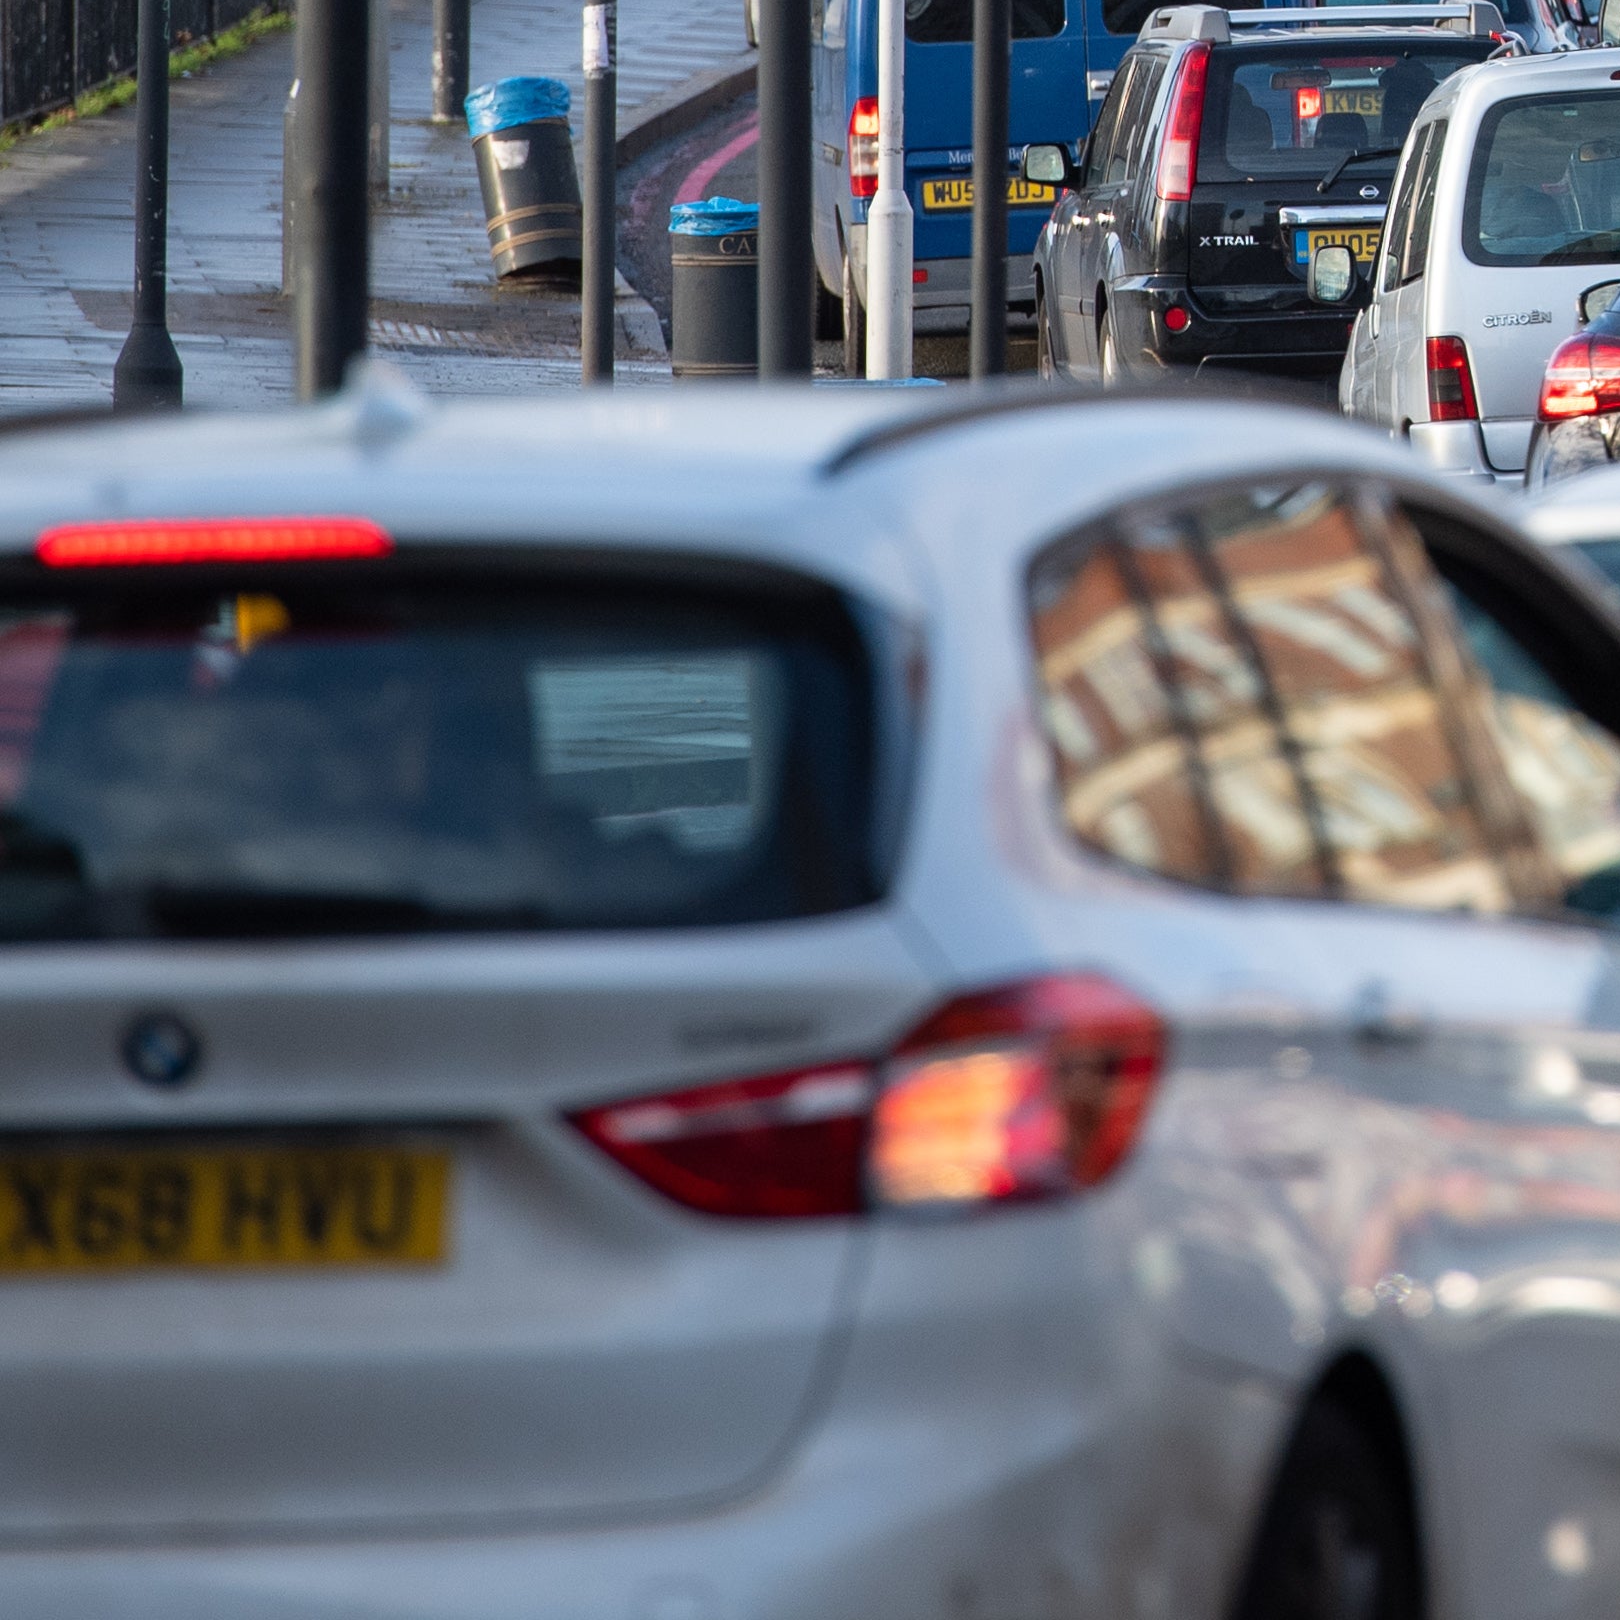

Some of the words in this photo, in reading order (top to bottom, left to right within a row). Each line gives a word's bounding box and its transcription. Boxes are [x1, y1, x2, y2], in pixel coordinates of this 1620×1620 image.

[1199, 236, 1212, 247] X
[1213, 235, 1259, 247] TRAIL
[1482, 309, 1552, 328] CITROËN
